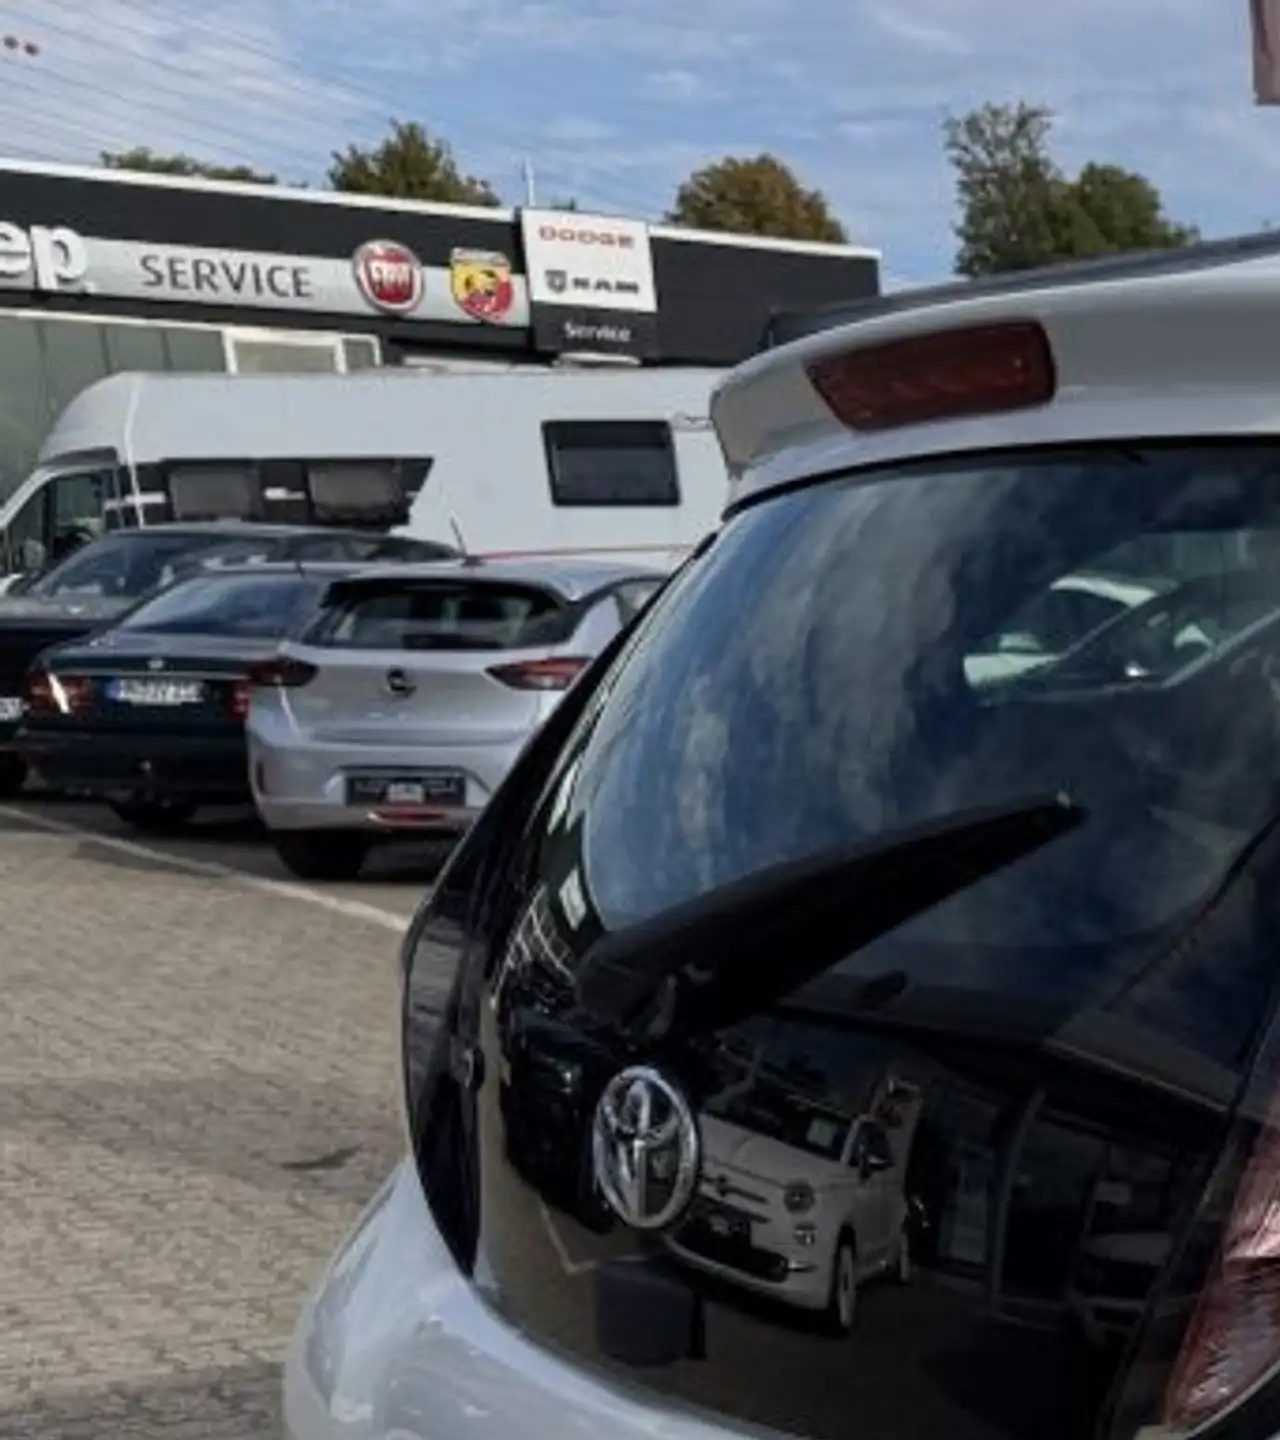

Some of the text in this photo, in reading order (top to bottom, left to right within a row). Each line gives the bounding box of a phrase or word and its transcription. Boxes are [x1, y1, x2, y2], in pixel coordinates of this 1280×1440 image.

[538, 225, 634, 249] DODGE
[139, 254, 314, 298] SERVICE
[572, 277, 639, 295] RAM
[564, 321, 632, 342] Service
